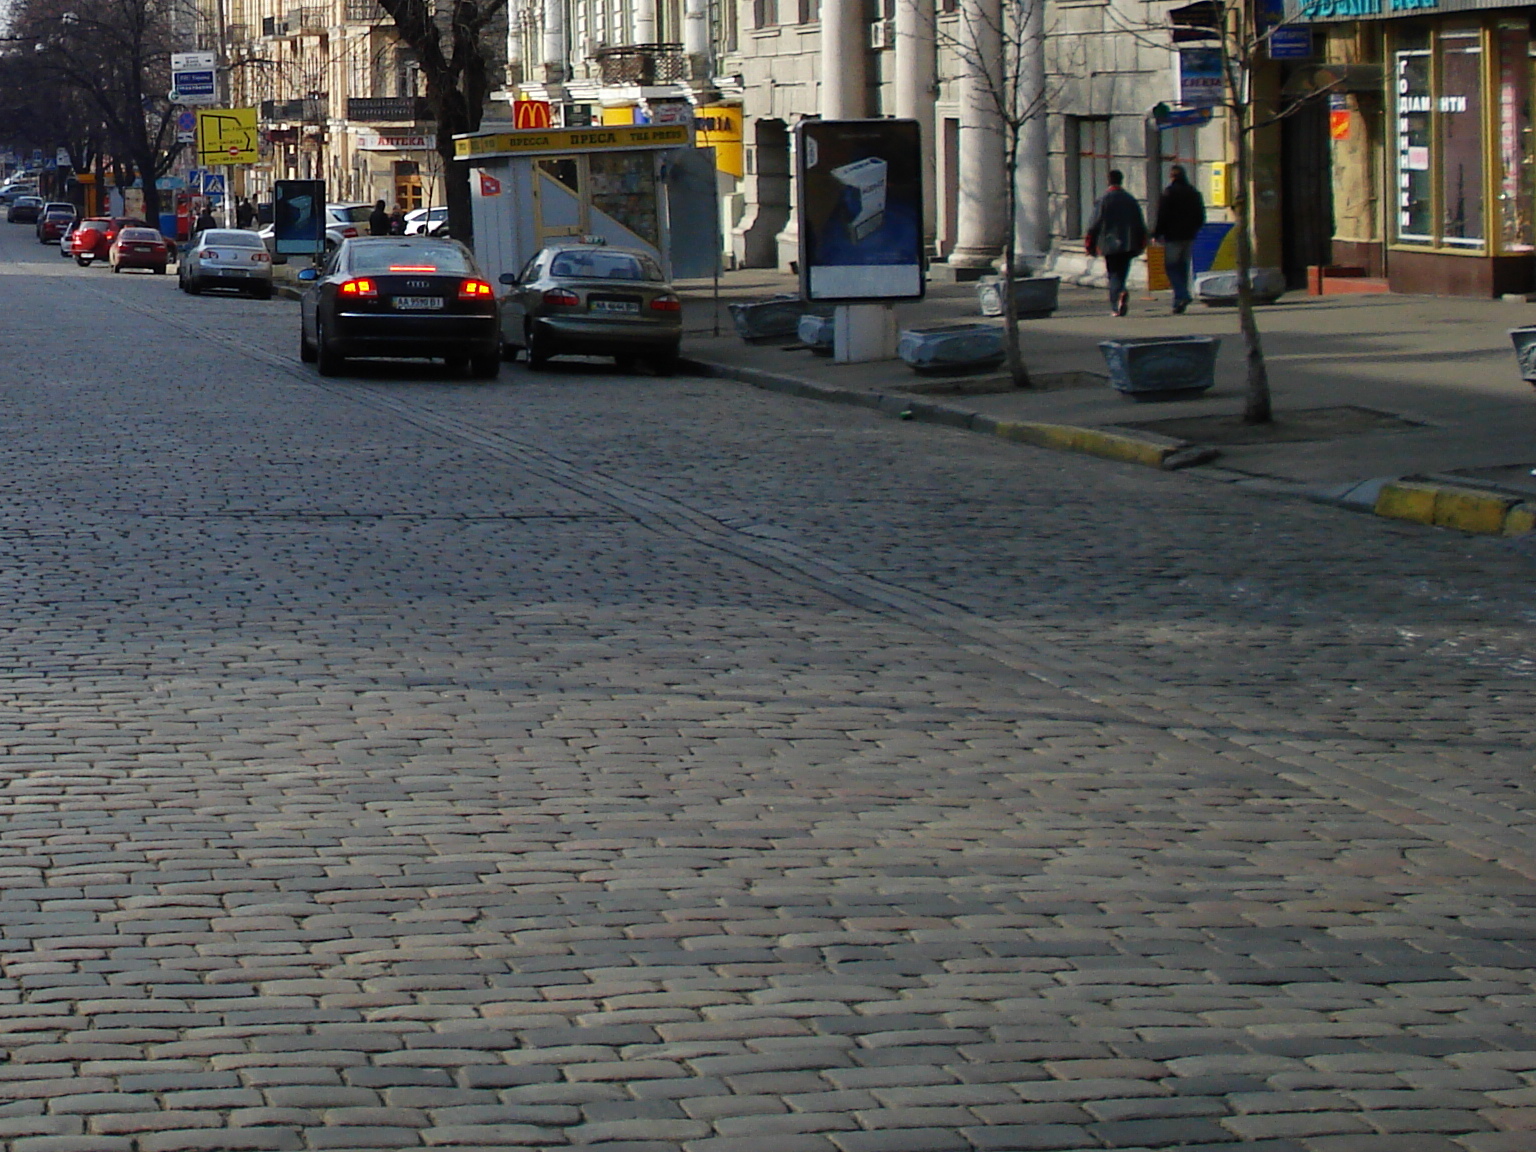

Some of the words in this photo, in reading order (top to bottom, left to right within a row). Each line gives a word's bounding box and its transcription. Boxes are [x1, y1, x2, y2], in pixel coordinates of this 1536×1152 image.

[1400, 96, 1467, 112] ДІАМНТИ
[378, 137, 425, 146] АПТЕКА
[510, 136, 549, 147] ПРЕССА
[570, 133, 617, 145] ПРЕСА
